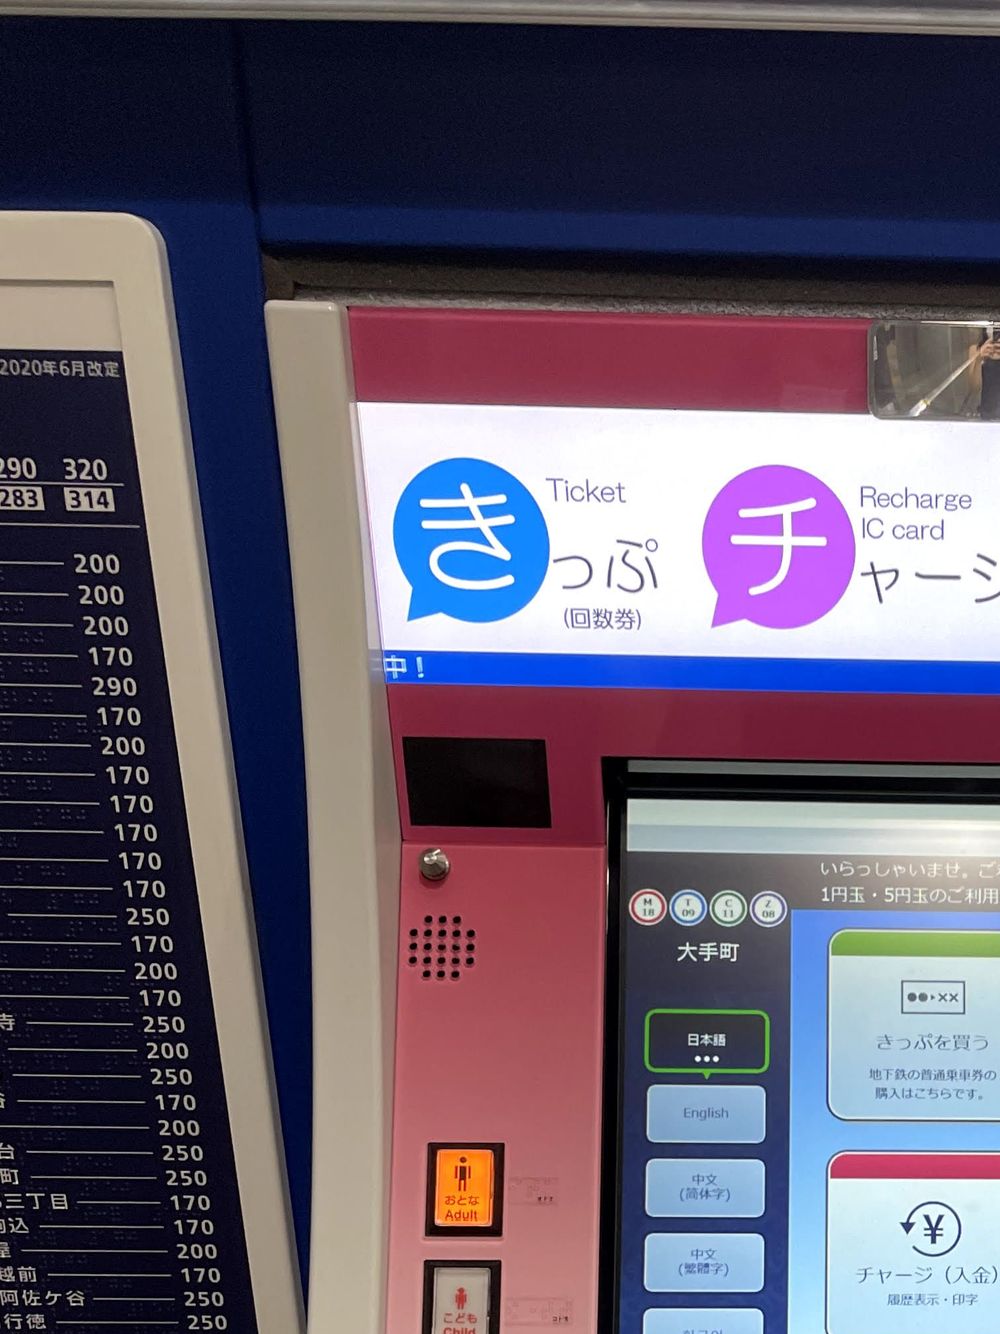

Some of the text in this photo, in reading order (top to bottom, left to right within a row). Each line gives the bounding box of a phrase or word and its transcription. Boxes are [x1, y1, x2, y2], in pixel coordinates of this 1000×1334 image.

[0, 359, 120, 378] 2020年6月改定
[63, 458, 108, 481] 320
[0, 488, 109, 508] 283 314
[545, 477, 626, 504] Ticket
[860, 485, 972, 511] Recharge
[861, 517, 945, 542] IC card
[73, 554, 120, 575] 200
[563, 607, 642, 631] (回数券)
[91, 677, 137, 697] 290
[114, 824, 158, 842] 170
[684, 899, 692, 907] T
[724, 899, 733, 908] C
[764, 900, 772, 908] Z
[126, 908, 170, 926] 250
[641, 908, 655, 917] 18
[681, 908, 695, 917] 09
[722, 909, 735, 918] 11
[761, 910, 776, 919] 08
[677, 941, 740, 962] 大手町
[687, 1033, 726, 1047] 日本語
[876, 1033, 989, 1052] きっぷを買う
[146, 1043, 189, 1060] 200
[869, 1068, 997, 1082] 地下鉄の普通乗車券の
[875, 1086, 985, 1101] 購入はこちらです。
[683, 1107, 729, 1121] English
[691, 1173, 718, 1187] 中文
[444, 1194, 480, 1207] おとな
[679, 1187, 731, 1202] (简体字)
[445, 1209, 479, 1222] Adult
[690, 1248, 717, 1261] 中文
[180, 1268, 221, 1283] 170
[677, 1262, 729, 1277] (繁體字)
[183, 1292, 224, 1307] 250
[887, 1293, 979, 1307] 履歴表示・印字
[187, 1316, 227, 1330] 250
[443, 1312, 478, 1324] こども
